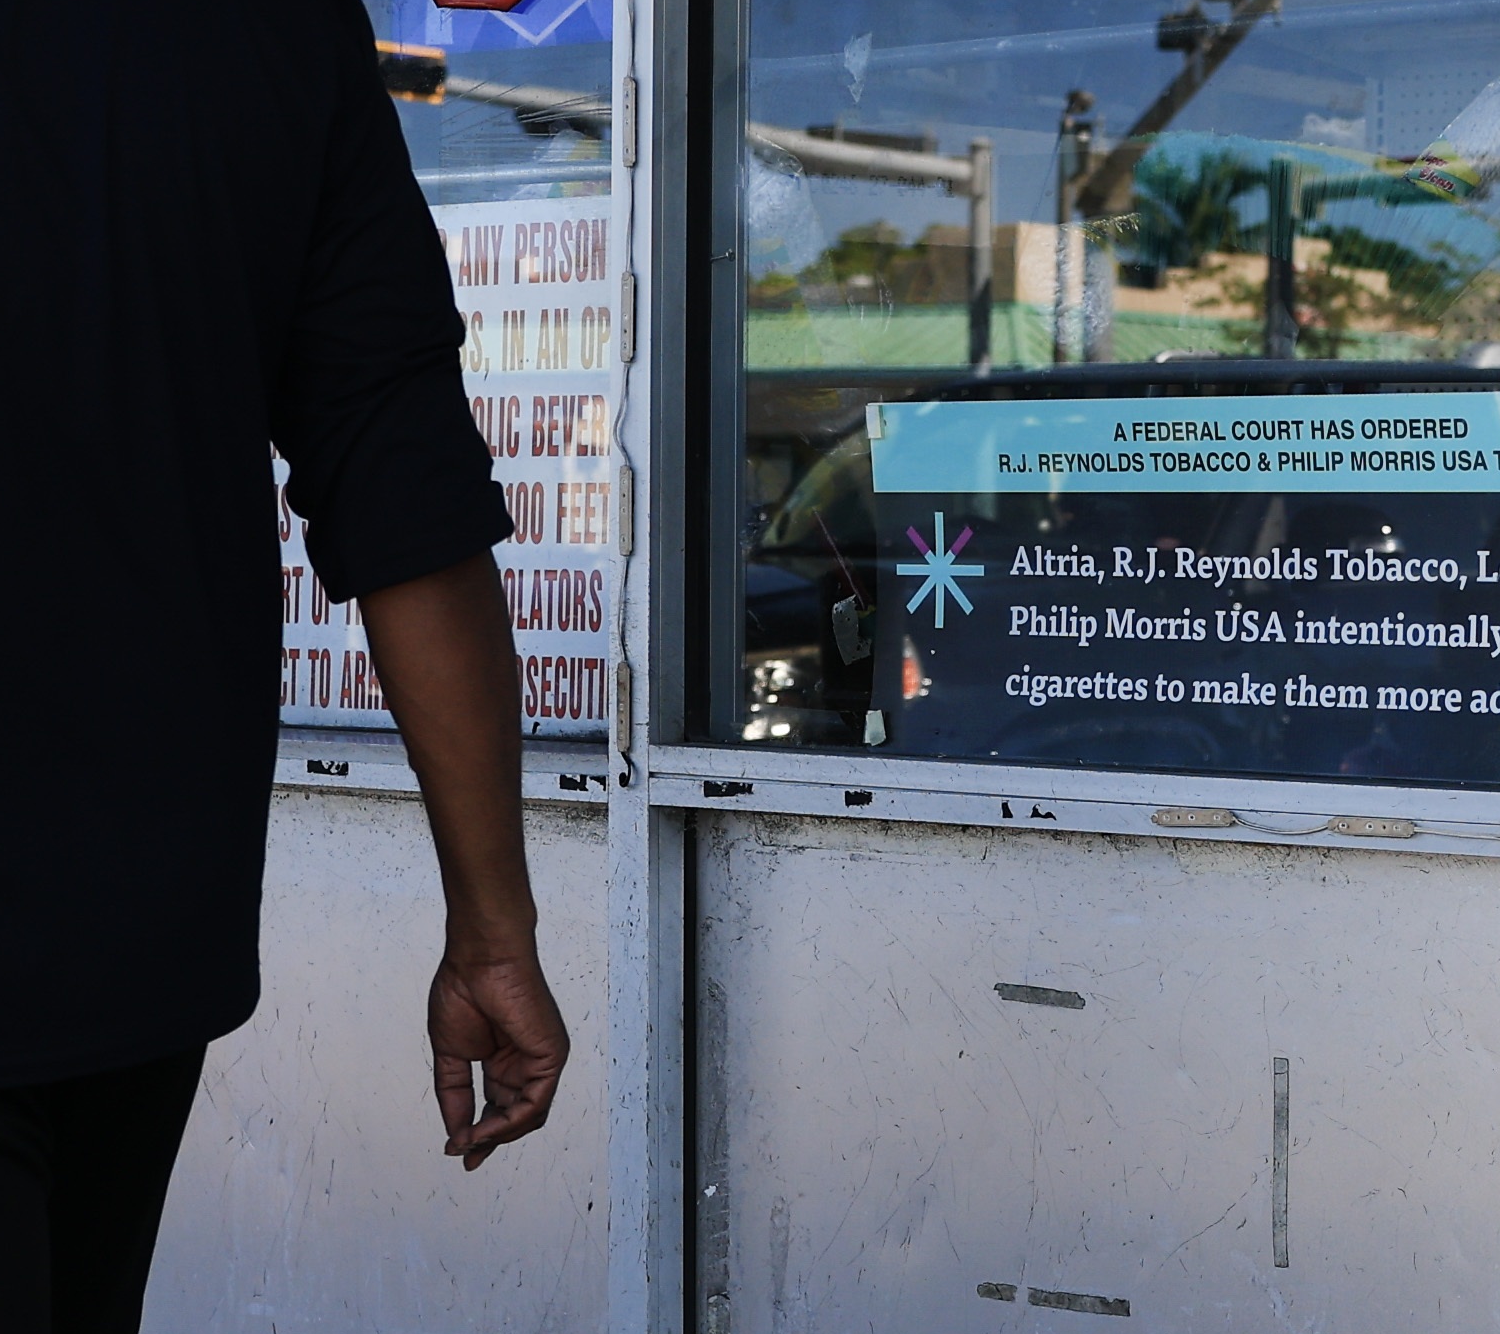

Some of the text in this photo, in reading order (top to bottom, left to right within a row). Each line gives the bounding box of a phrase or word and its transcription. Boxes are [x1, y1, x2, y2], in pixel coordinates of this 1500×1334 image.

[458, 225, 504, 287] ANY
[514, 218, 607, 284] PERSON
[502, 309, 525, 371] IN
[537, 308, 569, 370] AN
[469, 395, 610, 458] OLIC BEVER
[1114, 418, 1469, 442] A FEDERAL COURT HAS ORDERED
[999, 453, 1033, 473] R.J.
[1038, 452, 1145, 473] REYNOLDS
[1150, 451, 1252, 473] TOBACCO
[1258, 451, 1272, 472] &
[1278, 450, 1344, 472] PHILIP
[1350, 450, 1436, 471] MORRIS
[1442, 450, 1488, 471] USA
[556, 482, 611, 544] FEET
[1010, 546, 1105, 584] Altria,
[1112, 546, 1166, 581] R.J.
[1175, 548, 1319, 587] Reynolds
[1326, 549, 1468, 591] Tobacco,
[505, 568, 603, 633] OLATORS
[1010, 605, 1098, 647] Philip
[1105, 607, 1206, 643] Morris
[1216, 610, 1287, 644] USA
[308, 648, 610, 721] TO SECUTI
[1005, 668, 1149, 708] cigarettes
[1155, 674, 1186, 703] to
[1192, 672, 1276, 708] make
[1284, 676, 1369, 710] them
[1376, 684, 1463, 713] more
